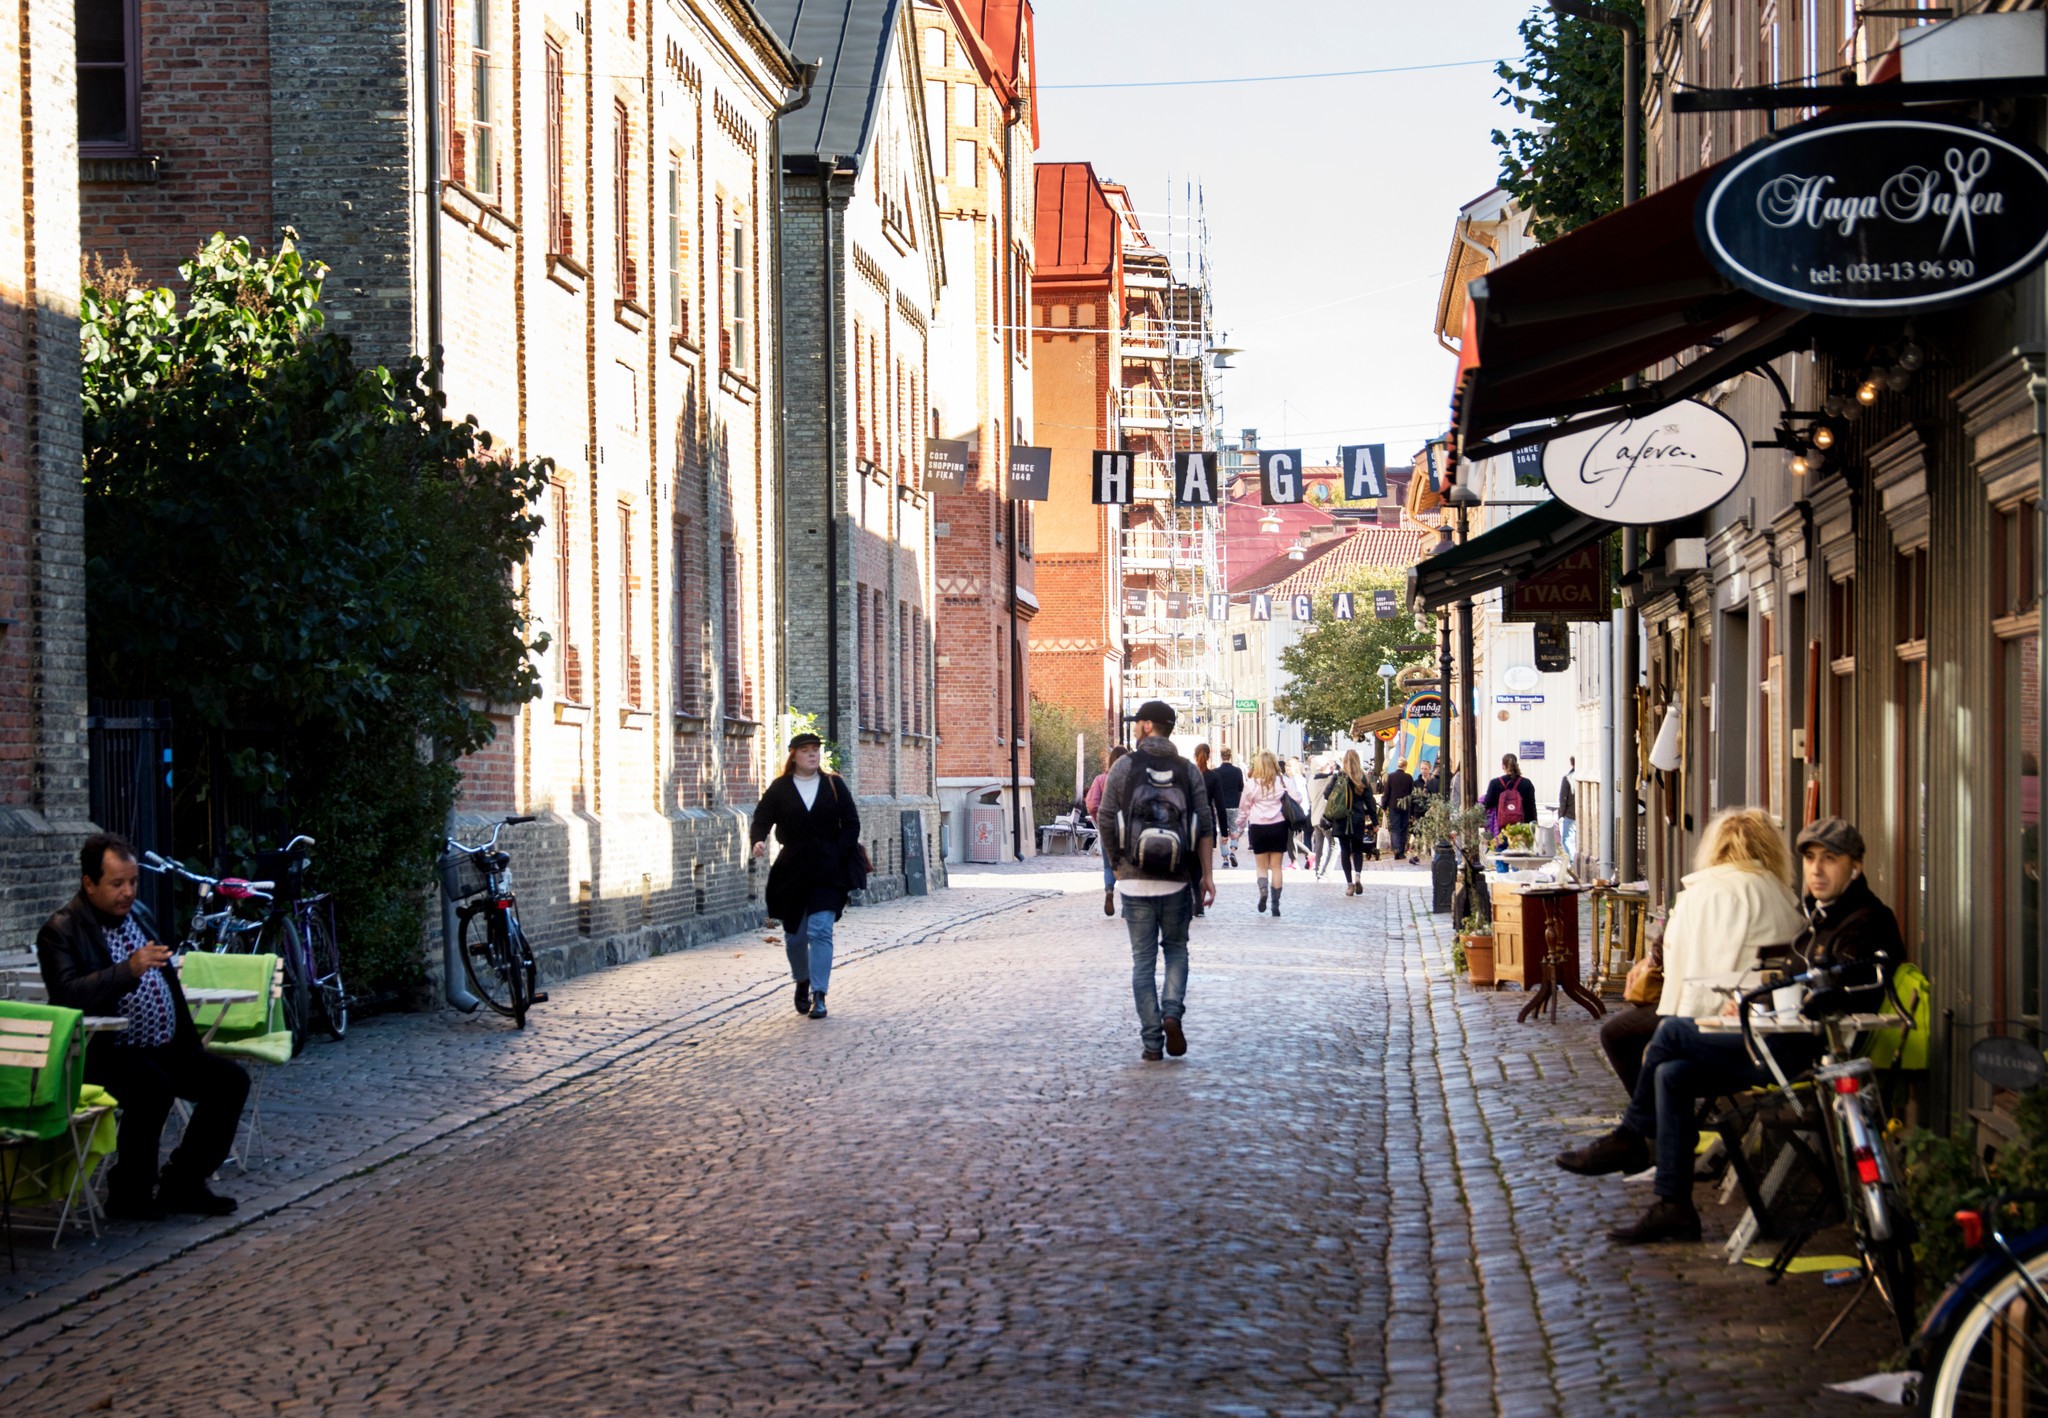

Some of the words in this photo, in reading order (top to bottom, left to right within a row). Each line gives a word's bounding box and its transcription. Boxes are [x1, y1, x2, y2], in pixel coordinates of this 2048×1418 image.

[1757, 173, 1878, 236] Haga
[1809, 264, 1842, 284] tel:
[1846, 261, 1915, 282] 031-13
[1918, 260, 1945, 279] 96
[1948, 258, 1975, 278] 90
[1516, 444, 1539, 455] SINCE
[929, 451, 948, 460] COSY
[1516, 453, 1537, 464] 1648
[928, 461, 964, 471] SHOPPING
[1012, 463, 1035, 472] SINCE
[935, 471, 953, 480] FIKA
[1011, 472, 1031, 481] 1648
